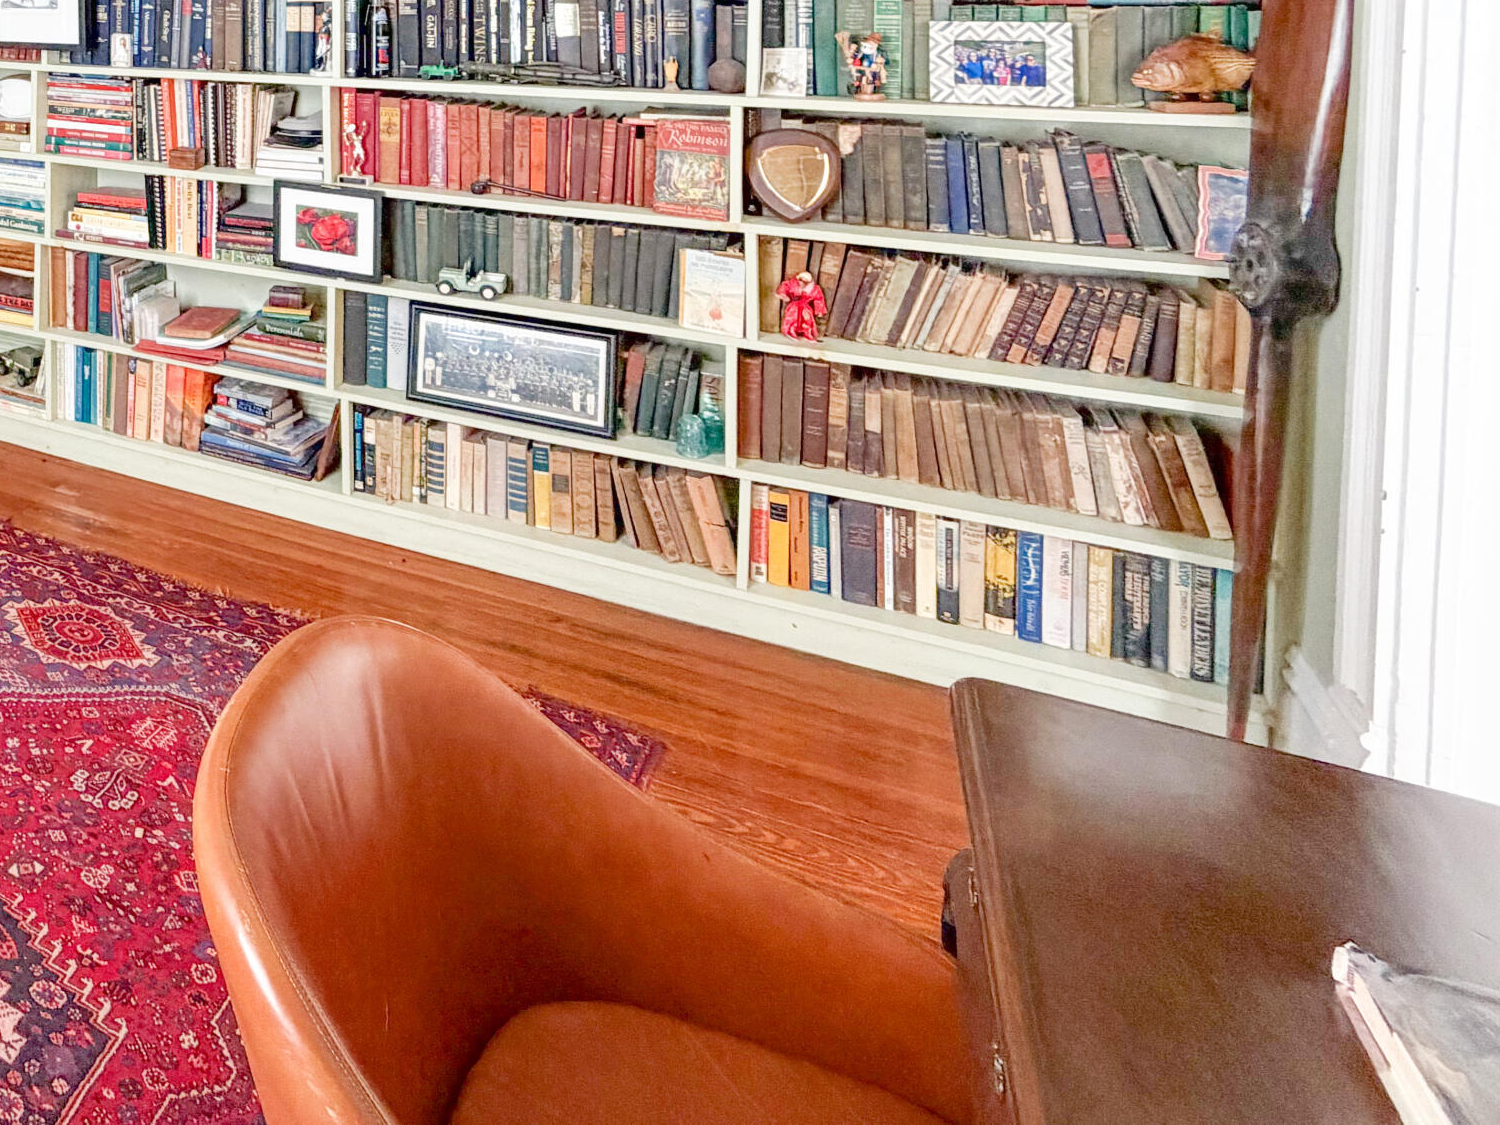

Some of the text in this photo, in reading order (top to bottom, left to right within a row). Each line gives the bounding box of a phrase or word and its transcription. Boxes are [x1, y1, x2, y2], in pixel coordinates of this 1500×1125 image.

[526, 5, 536, 27] Storm
[426, 14, 436, 49] GAI-JIN
[474, 15, 487, 64] TWINS
[525, 27, 536, 52] Rising
[665, 128, 728, 148] Robinson
[812, 546, 828, 582] RASPUTIN
